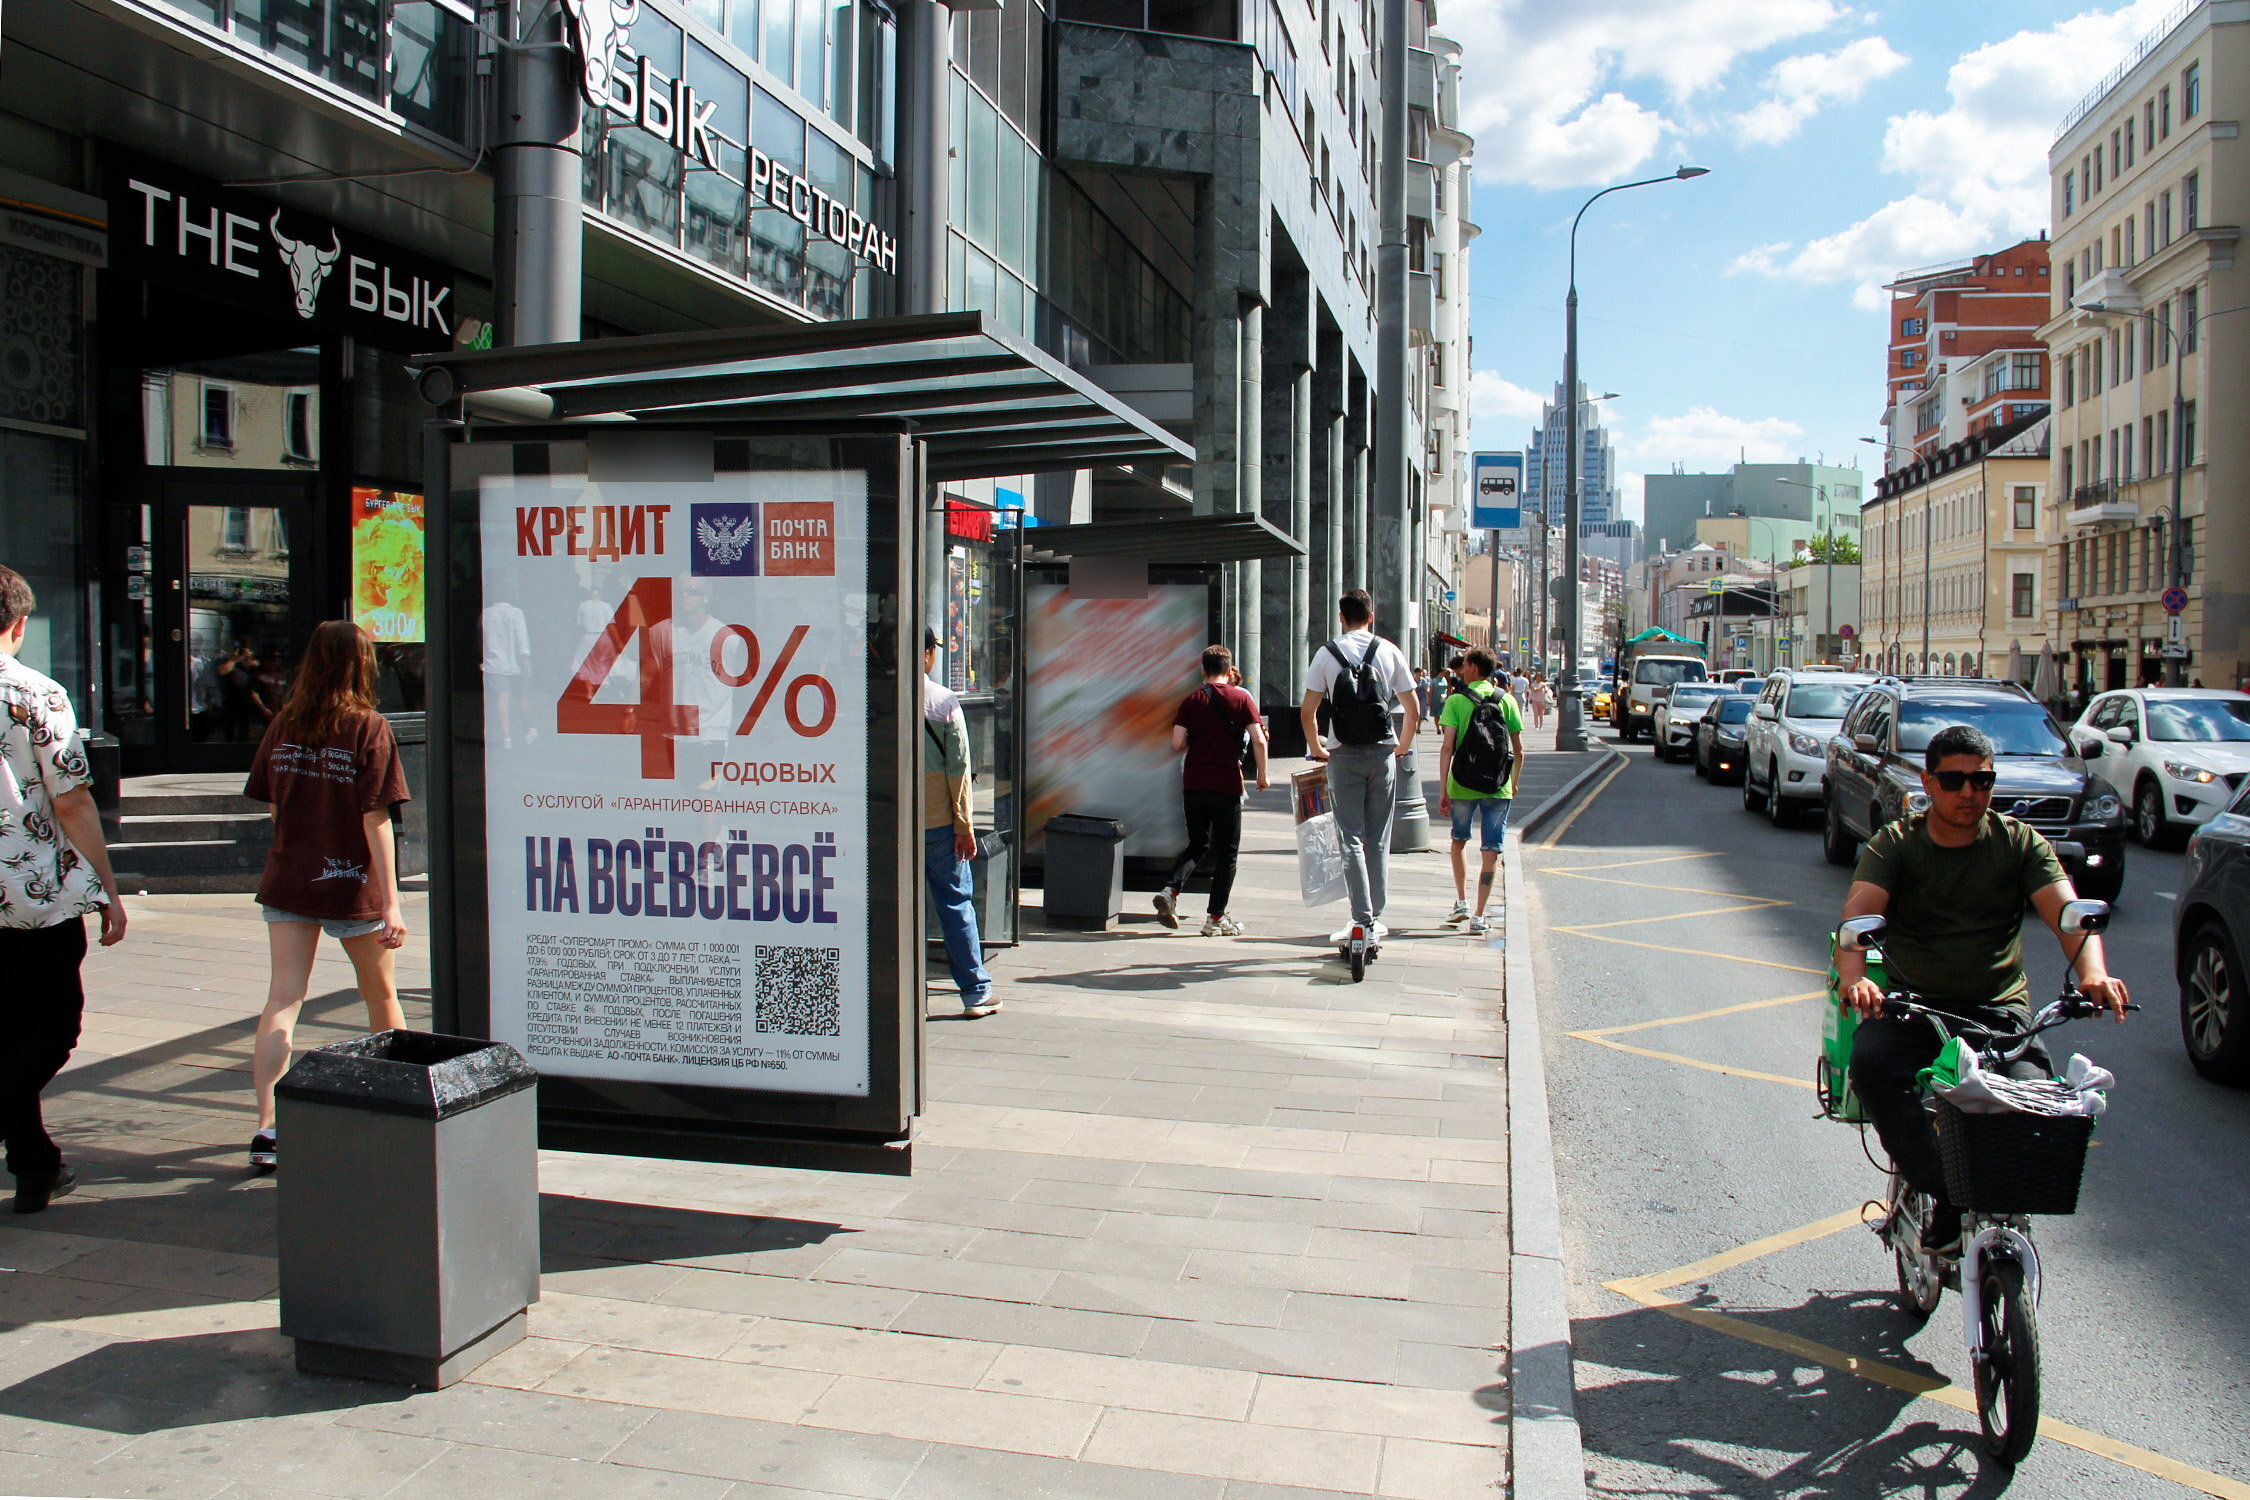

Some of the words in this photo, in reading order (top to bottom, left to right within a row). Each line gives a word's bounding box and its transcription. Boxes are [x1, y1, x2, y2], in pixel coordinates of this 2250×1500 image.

[747, 146, 896, 275] РЕСТОРАН
[129, 178, 260, 278] THE
[349, 254, 451, 335] БЫК
[365, 498, 389, 509] БУРГЕР
[516, 504, 671, 563] КРЕДИТ
[770, 519, 828, 537] ПОЧТА
[770, 542, 821, 559] БАНК
[557, 577, 837, 779] 4%
[711, 761, 836, 785] ГОДОВЫХ
[523, 794, 534, 808] С
[537, 793, 604, 809] УСЛУГОЙ
[611, 796, 765, 815] «ГАРАНТИРОВАННАЯ
[769, 800, 839, 816] СТАВКА»
[526, 836, 580, 913] НА
[587, 827, 838, 925] ВСЁВСЁВСЁ
[526, 934, 557, 944] КРЕДИТ
[655, 941, 686, 951] СУММА
[687, 943, 700, 952] ОТ
[703, 944, 706, 952] 1
[709, 944, 724, 953] 000
[725, 945, 739, 954] 001
[526, 945, 539, 954] ДО
[540, 945, 545, 954] 6
[546, 946, 561, 955] 000
[562, 947, 577, 956] 000
[613, 950, 635, 959] СРОК
[637, 951, 648, 960] ОТ
[650, 952, 655, 960] 3
[656, 952, 670, 962] ДО
[671, 953, 677, 962] 7
[698, 955, 730, 965] СТАВКА
[607, 960, 624, 970] ПРИ
[633, 962, 698, 975] ПОДКЛЮЧЕНИИ
[708, 966, 740, 977] УСЛУГИ
[526, 978, 564, 990] РАЗНИЦА
[564, 981, 595, 992] МЕЖДУ
[595, 981, 632, 993] СУММОЙ
[633, 985, 685, 997] ПРОЦЕНТОВ,
[685, 988, 741, 999] УПЛАЧЕННЫХ
[668, 975, 741, 988] ВЫПЛАЧИВАЕТСЯ
[527, 1001, 539, 1010] ПО
[546, 1002, 576, 1012] СТАВКЕ
[583, 1004, 595, 1013] 4%
[652, 1008, 681, 1018] ПОСЛЕ
[689, 1010, 741, 1022] ПОГАШЕНИЯ
[574, 993, 581, 1001] И
[583, 992, 620, 1003] СУММОЙ
[622, 995, 673, 1007] ПРОЦЕНТОВ,
[675, 998, 741, 1010] РАССЧИТАННЫХ
[527, 1012, 562, 1023] КРЕДИТА
[564, 1014, 581, 1024] ПРИ
[583, 1015, 627, 1026] ВНЕСЕНИИ
[630, 1018, 641, 1027] НЕ
[643, 1019, 672, 1029] МЕНЕЕ
[675, 1021, 684, 1030] 12
[686, 1020, 732, 1032] ПЛАТЕЖЕЙ
[734, 1024, 741, 1033] И
[526, 1023, 578, 1035] ОТСУТСТВИИ
[603, 1028, 641, 1038] СЛУЧАЕВ
[667, 1032, 741, 1044] ВОЗНИКНОВЕНИЯ
[527, 1034, 592, 1047] ПРОСРОЧЕННОЙ
[670, 1043, 718, 1054] КОМИССИЯ
[718, 1046, 731, 1055] ЗА
[731, 1046, 763, 1057] УСЛУГУ
[776, 1049, 791, 1059] 11%
[792, 1050, 804, 1059] ОТ
[805, 1051, 840, 1061] СУММЫ
[527, 1046, 562, 1057] КРЕДИТА
[563, 1048, 569, 1057] К
[606, 1051, 619, 1060] АО
[681, 1055, 730, 1067] ЛИЦЕНЗИЯ
[730, 1058, 744, 1068] ЦБ
[744, 1059, 759, 1068] РФ
